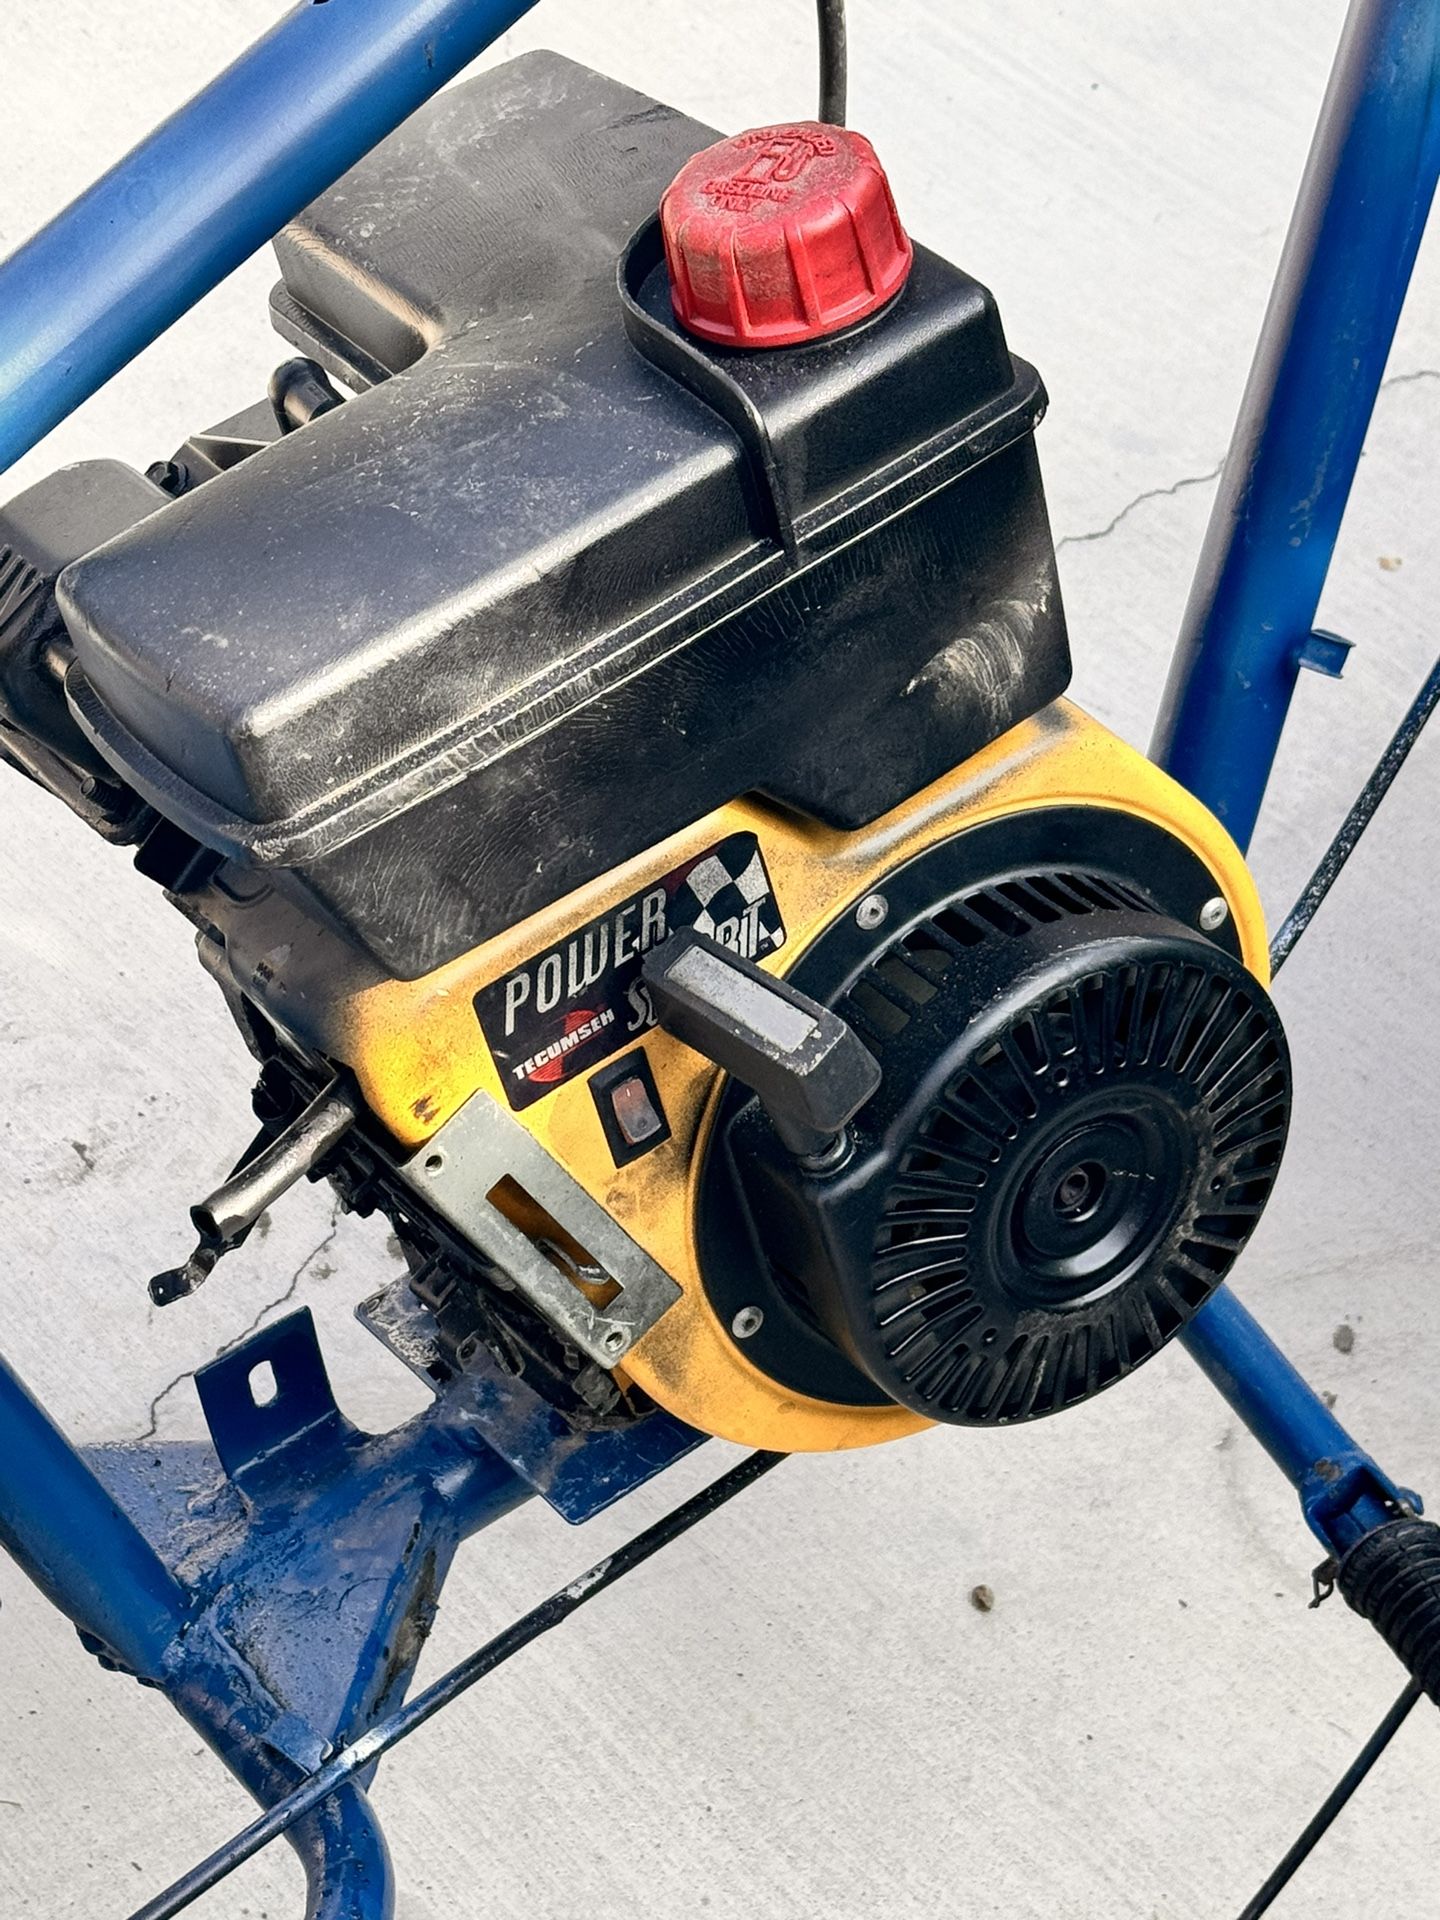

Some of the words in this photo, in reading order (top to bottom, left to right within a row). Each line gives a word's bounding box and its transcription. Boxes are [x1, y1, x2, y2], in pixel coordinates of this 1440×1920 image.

[505, 888, 667, 1036] POWER
[623, 897, 766, 1031] SRT
[512, 1008, 615, 1080] TECUMSEH
